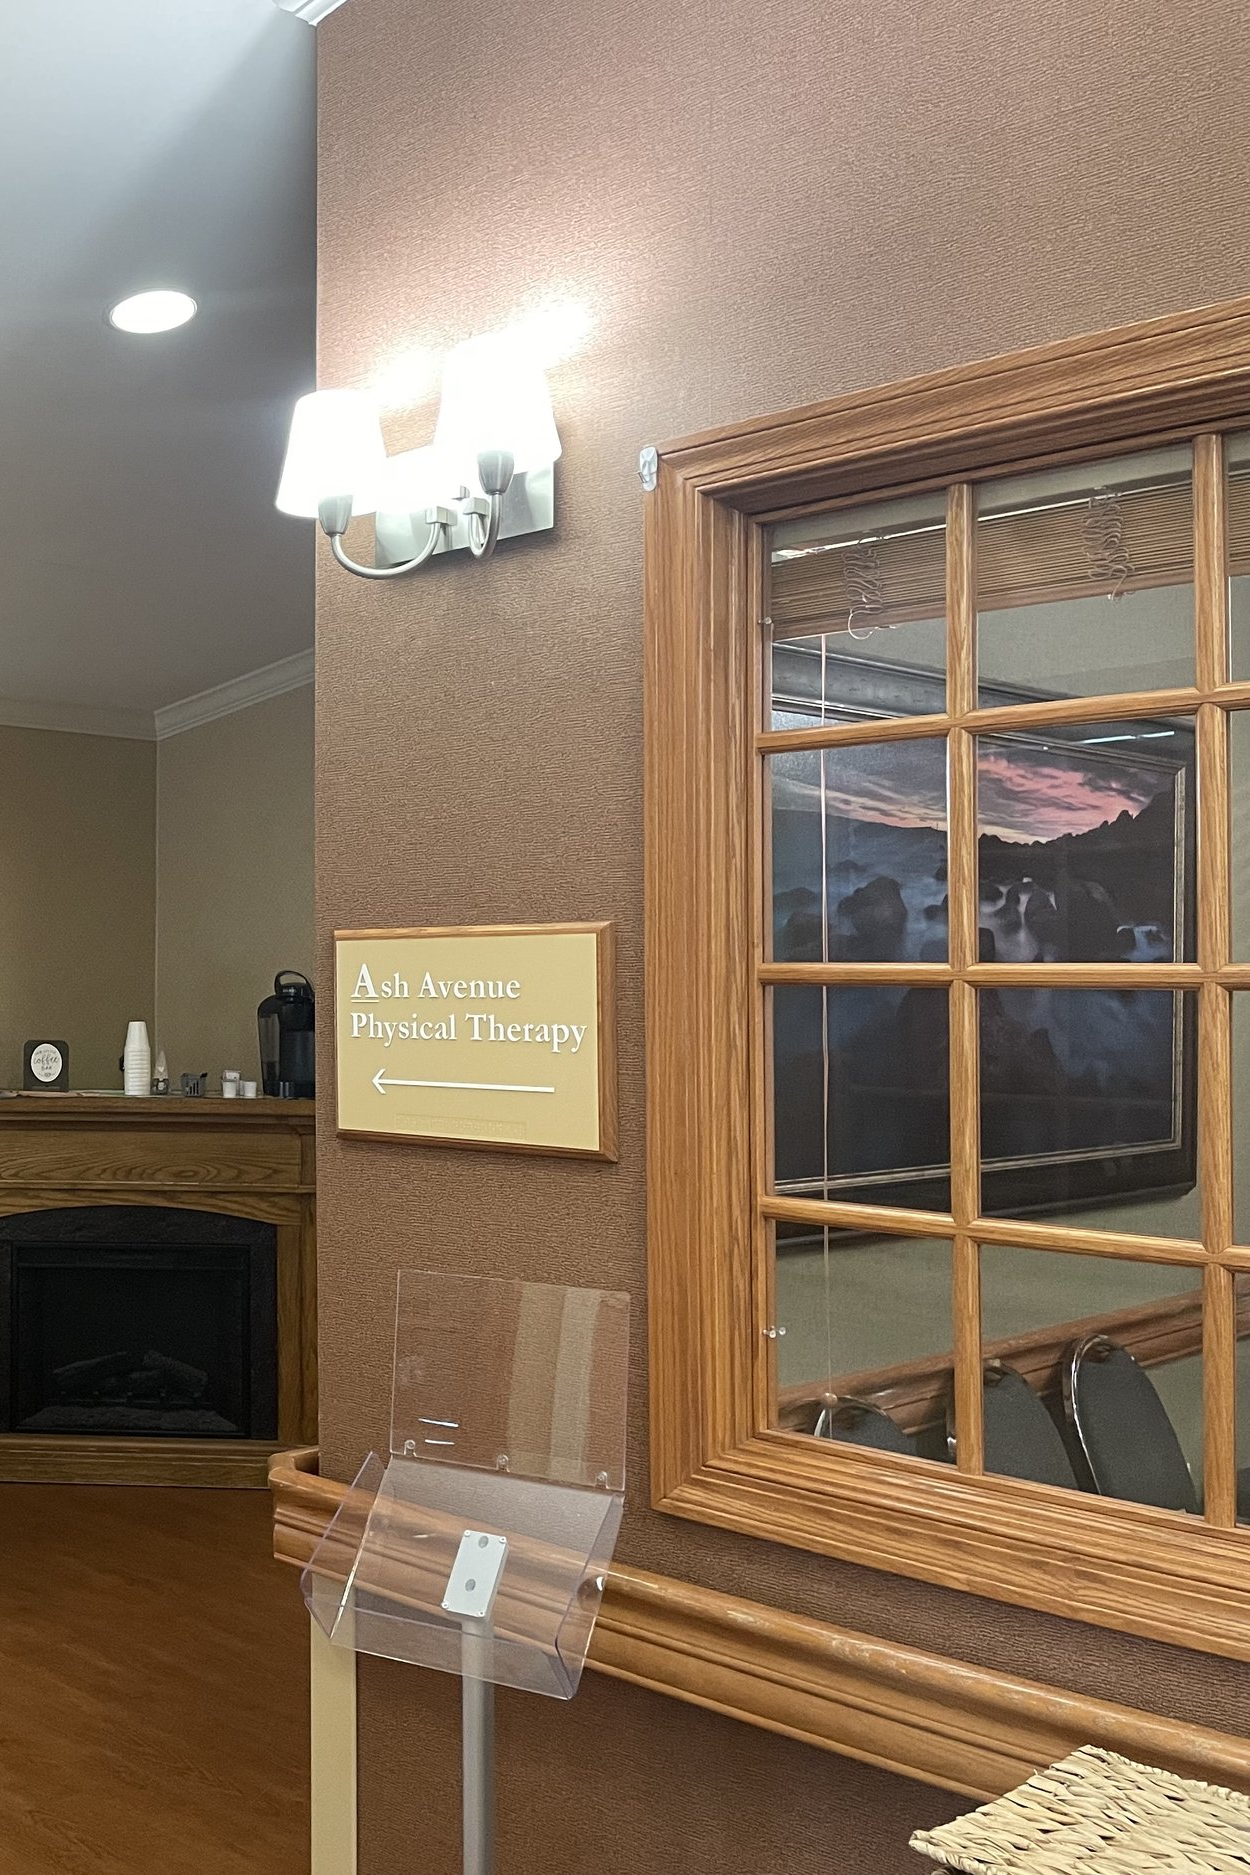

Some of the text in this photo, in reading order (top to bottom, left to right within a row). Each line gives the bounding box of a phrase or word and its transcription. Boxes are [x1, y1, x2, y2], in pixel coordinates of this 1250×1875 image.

[350, 963, 521, 1002] Ash Avenue
[350, 1012, 587, 1053] Physical Therapy
